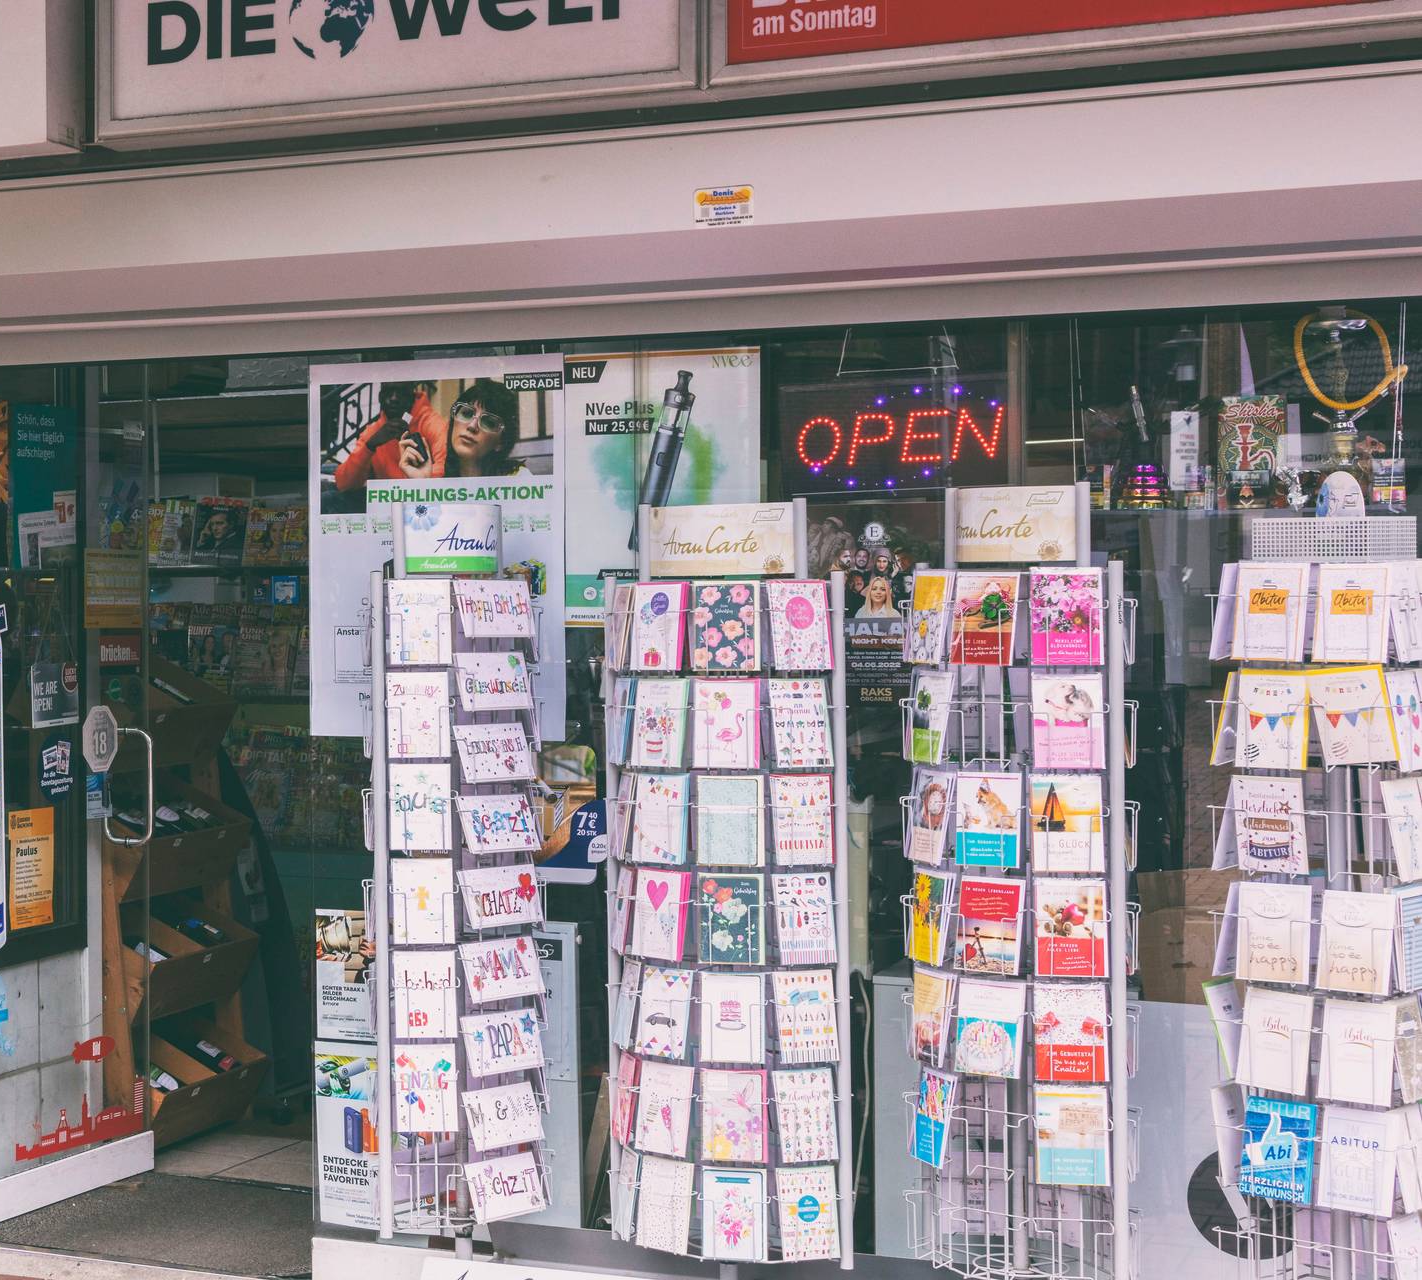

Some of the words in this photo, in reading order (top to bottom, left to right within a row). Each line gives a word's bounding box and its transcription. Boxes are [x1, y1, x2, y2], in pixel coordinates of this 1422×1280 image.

[752, 14, 785, 37] am
[789, 5, 877, 33] Sonntag
[146, 0, 277, 66] DIE
[572, 366, 596, 379] NEU
[505, 378, 561, 390] UPGRADE
[585, 401, 621, 416] NVee
[623, 400, 655, 415] Plus
[1225, 402, 1278, 418] Shisha
[588, 420, 608, 433] Nur
[797, 405, 1006, 469] OPEN
[100, 644, 131, 662] Drücken
[33, 681, 45, 697] WE
[45, 680, 59, 695] ARE
[860, 687, 893, 697] RAKS
[33, 697, 54, 713] OPEN!
[92, 730, 108, 755] 18
[576, 811, 588, 829] 7
[15, 845, 38, 858] Paulus
[478, 949, 528, 981] MAMA
[486, 1021, 525, 1060] PAPA
[1246, 1098, 1311, 1122] ABITUR
[1330, 1135, 1380, 1151] ABITUR
[322, 1154, 369, 1168] ENTDECKE
[1264, 1144, 1293, 1162] Abi
[323, 1164, 348, 1175] DEINE
[323, 1173, 370, 1186] FAVORITEN
[1240, 1174, 1305, 1192] HERZLICHEN
[1238, 1182, 1306, 1203] GLÜCKWUNSCH
